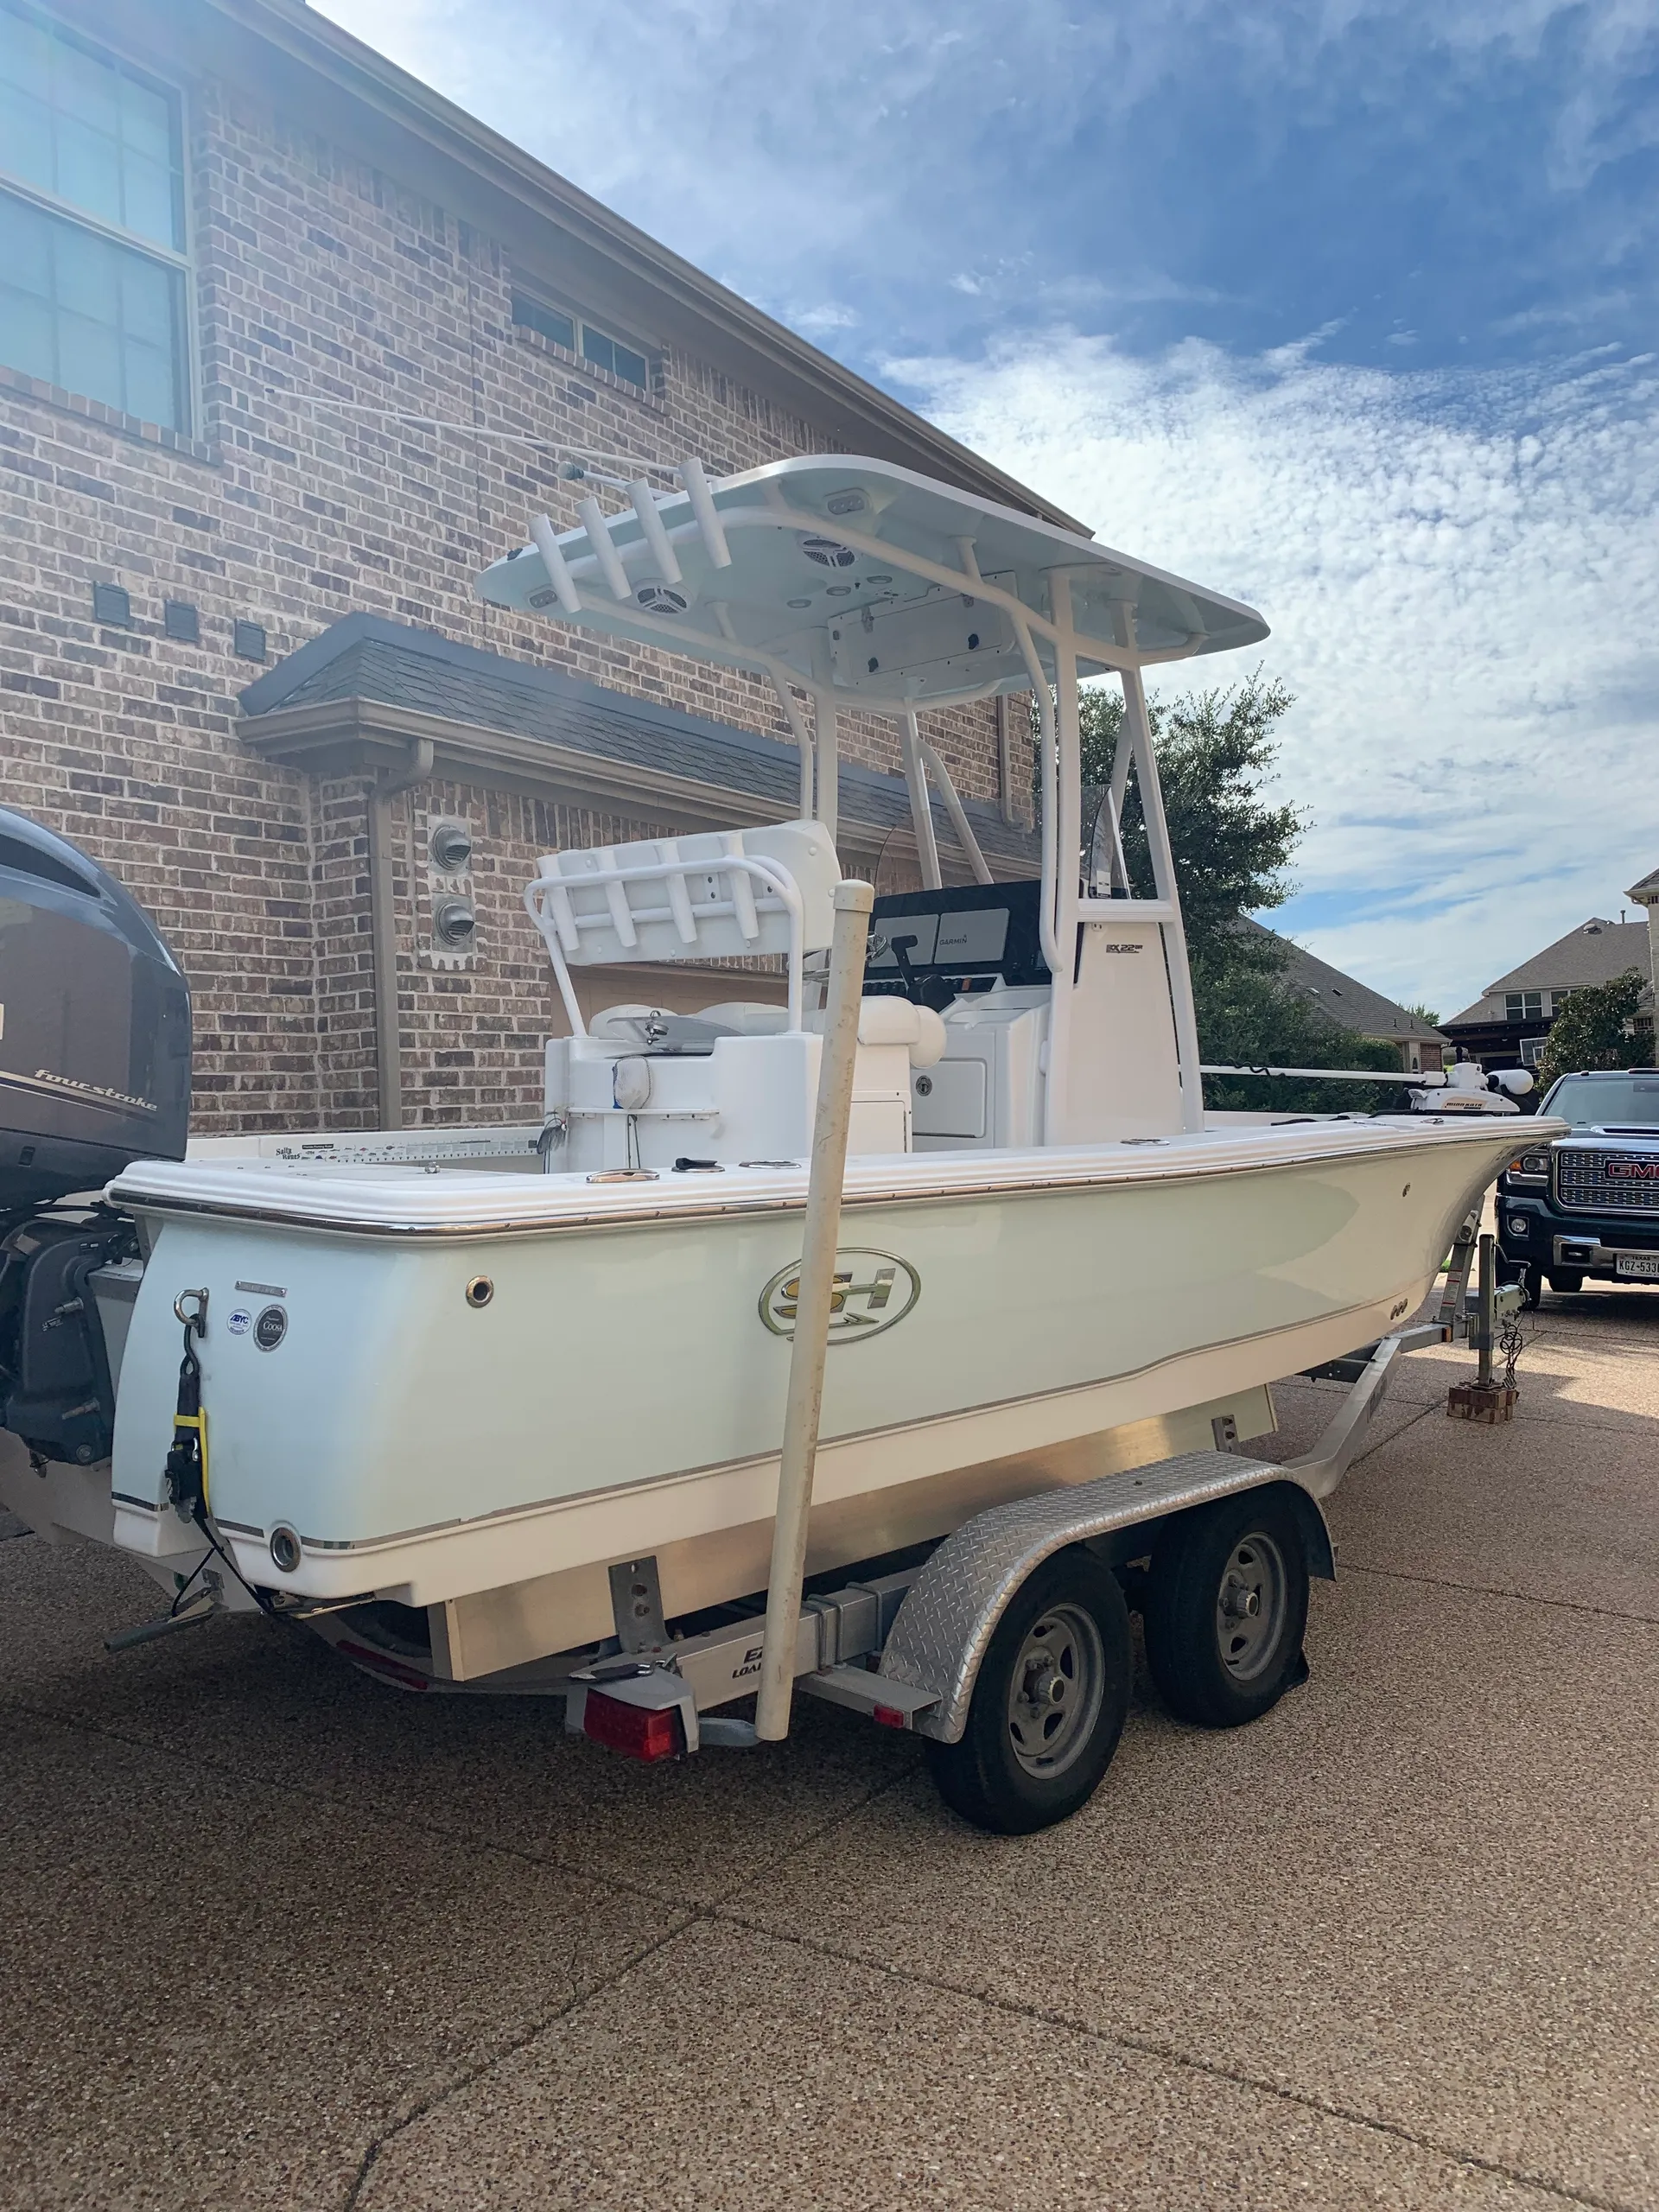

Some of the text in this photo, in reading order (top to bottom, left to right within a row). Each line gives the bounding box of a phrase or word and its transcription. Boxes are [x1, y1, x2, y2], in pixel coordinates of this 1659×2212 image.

[1608, 1162, 1659, 1179] GM
[1619, 1260, 1659, 1273] KGZ-533
[230, 1314, 249, 1324] ABYC
[743, 1645, 763, 1664] E
[732, 1662, 761, 1679] LOA
